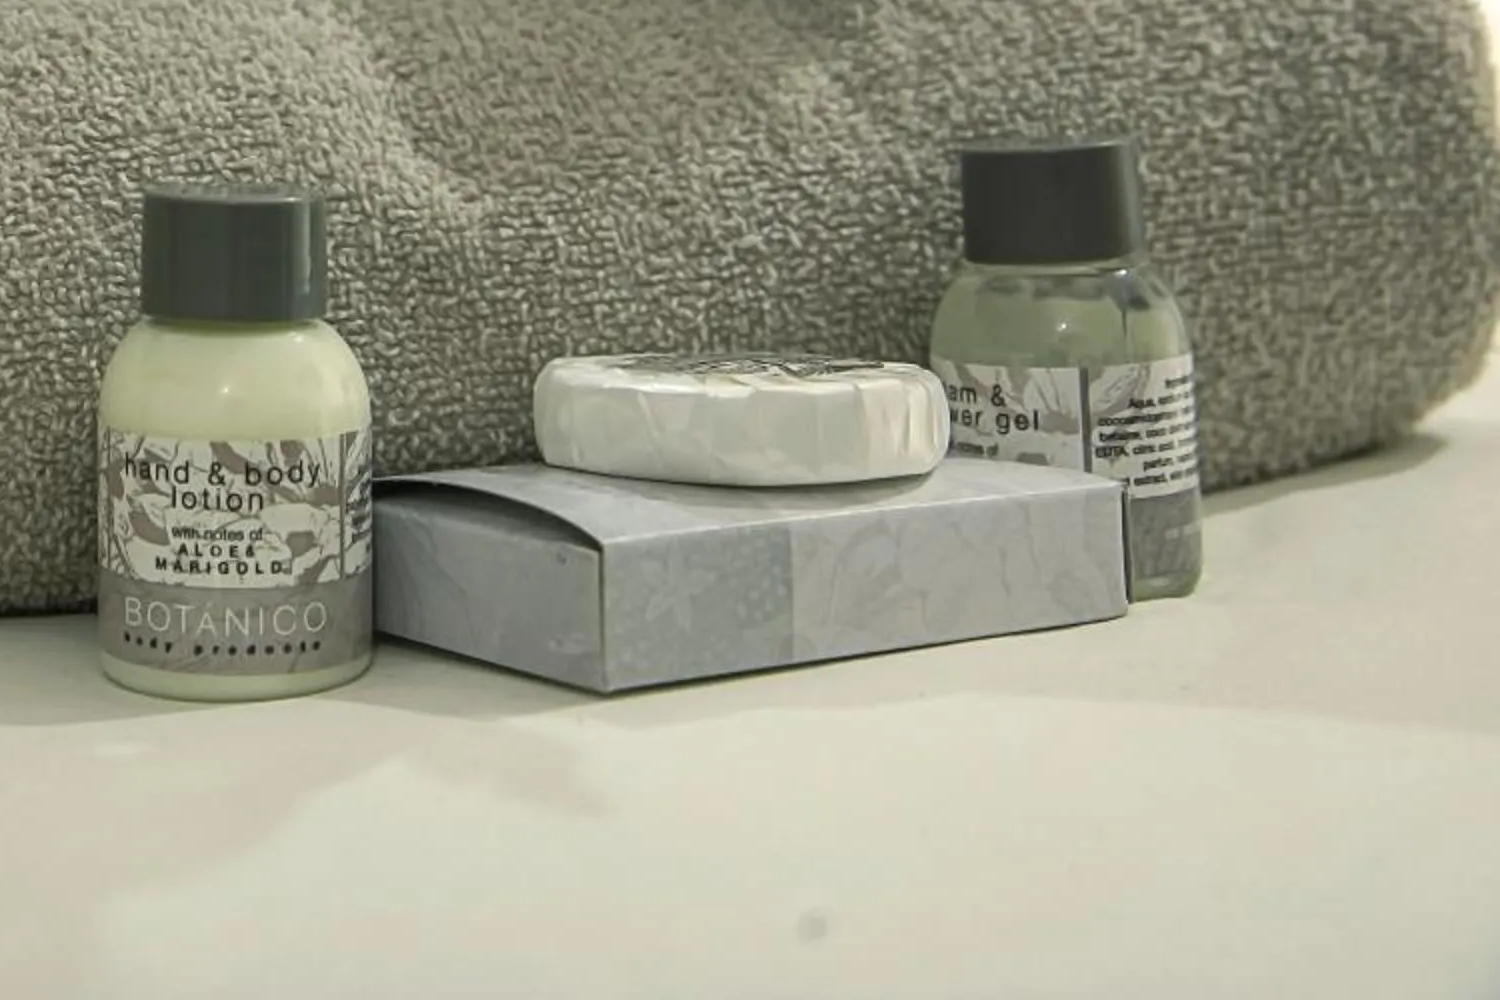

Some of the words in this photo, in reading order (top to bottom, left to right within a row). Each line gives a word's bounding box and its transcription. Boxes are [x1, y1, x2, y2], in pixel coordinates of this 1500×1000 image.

[946, 384, 977, 404] am
[990, 384, 1006, 407] &
[995, 409, 1039, 435] gel
[125, 452, 189, 484] hand
[208, 461, 225, 486] &
[244, 459, 320, 488] body
[171, 486, 264, 512] lotion
[177, 543, 239, 558] ALOE
[155, 556, 282, 575] MARIGOLD
